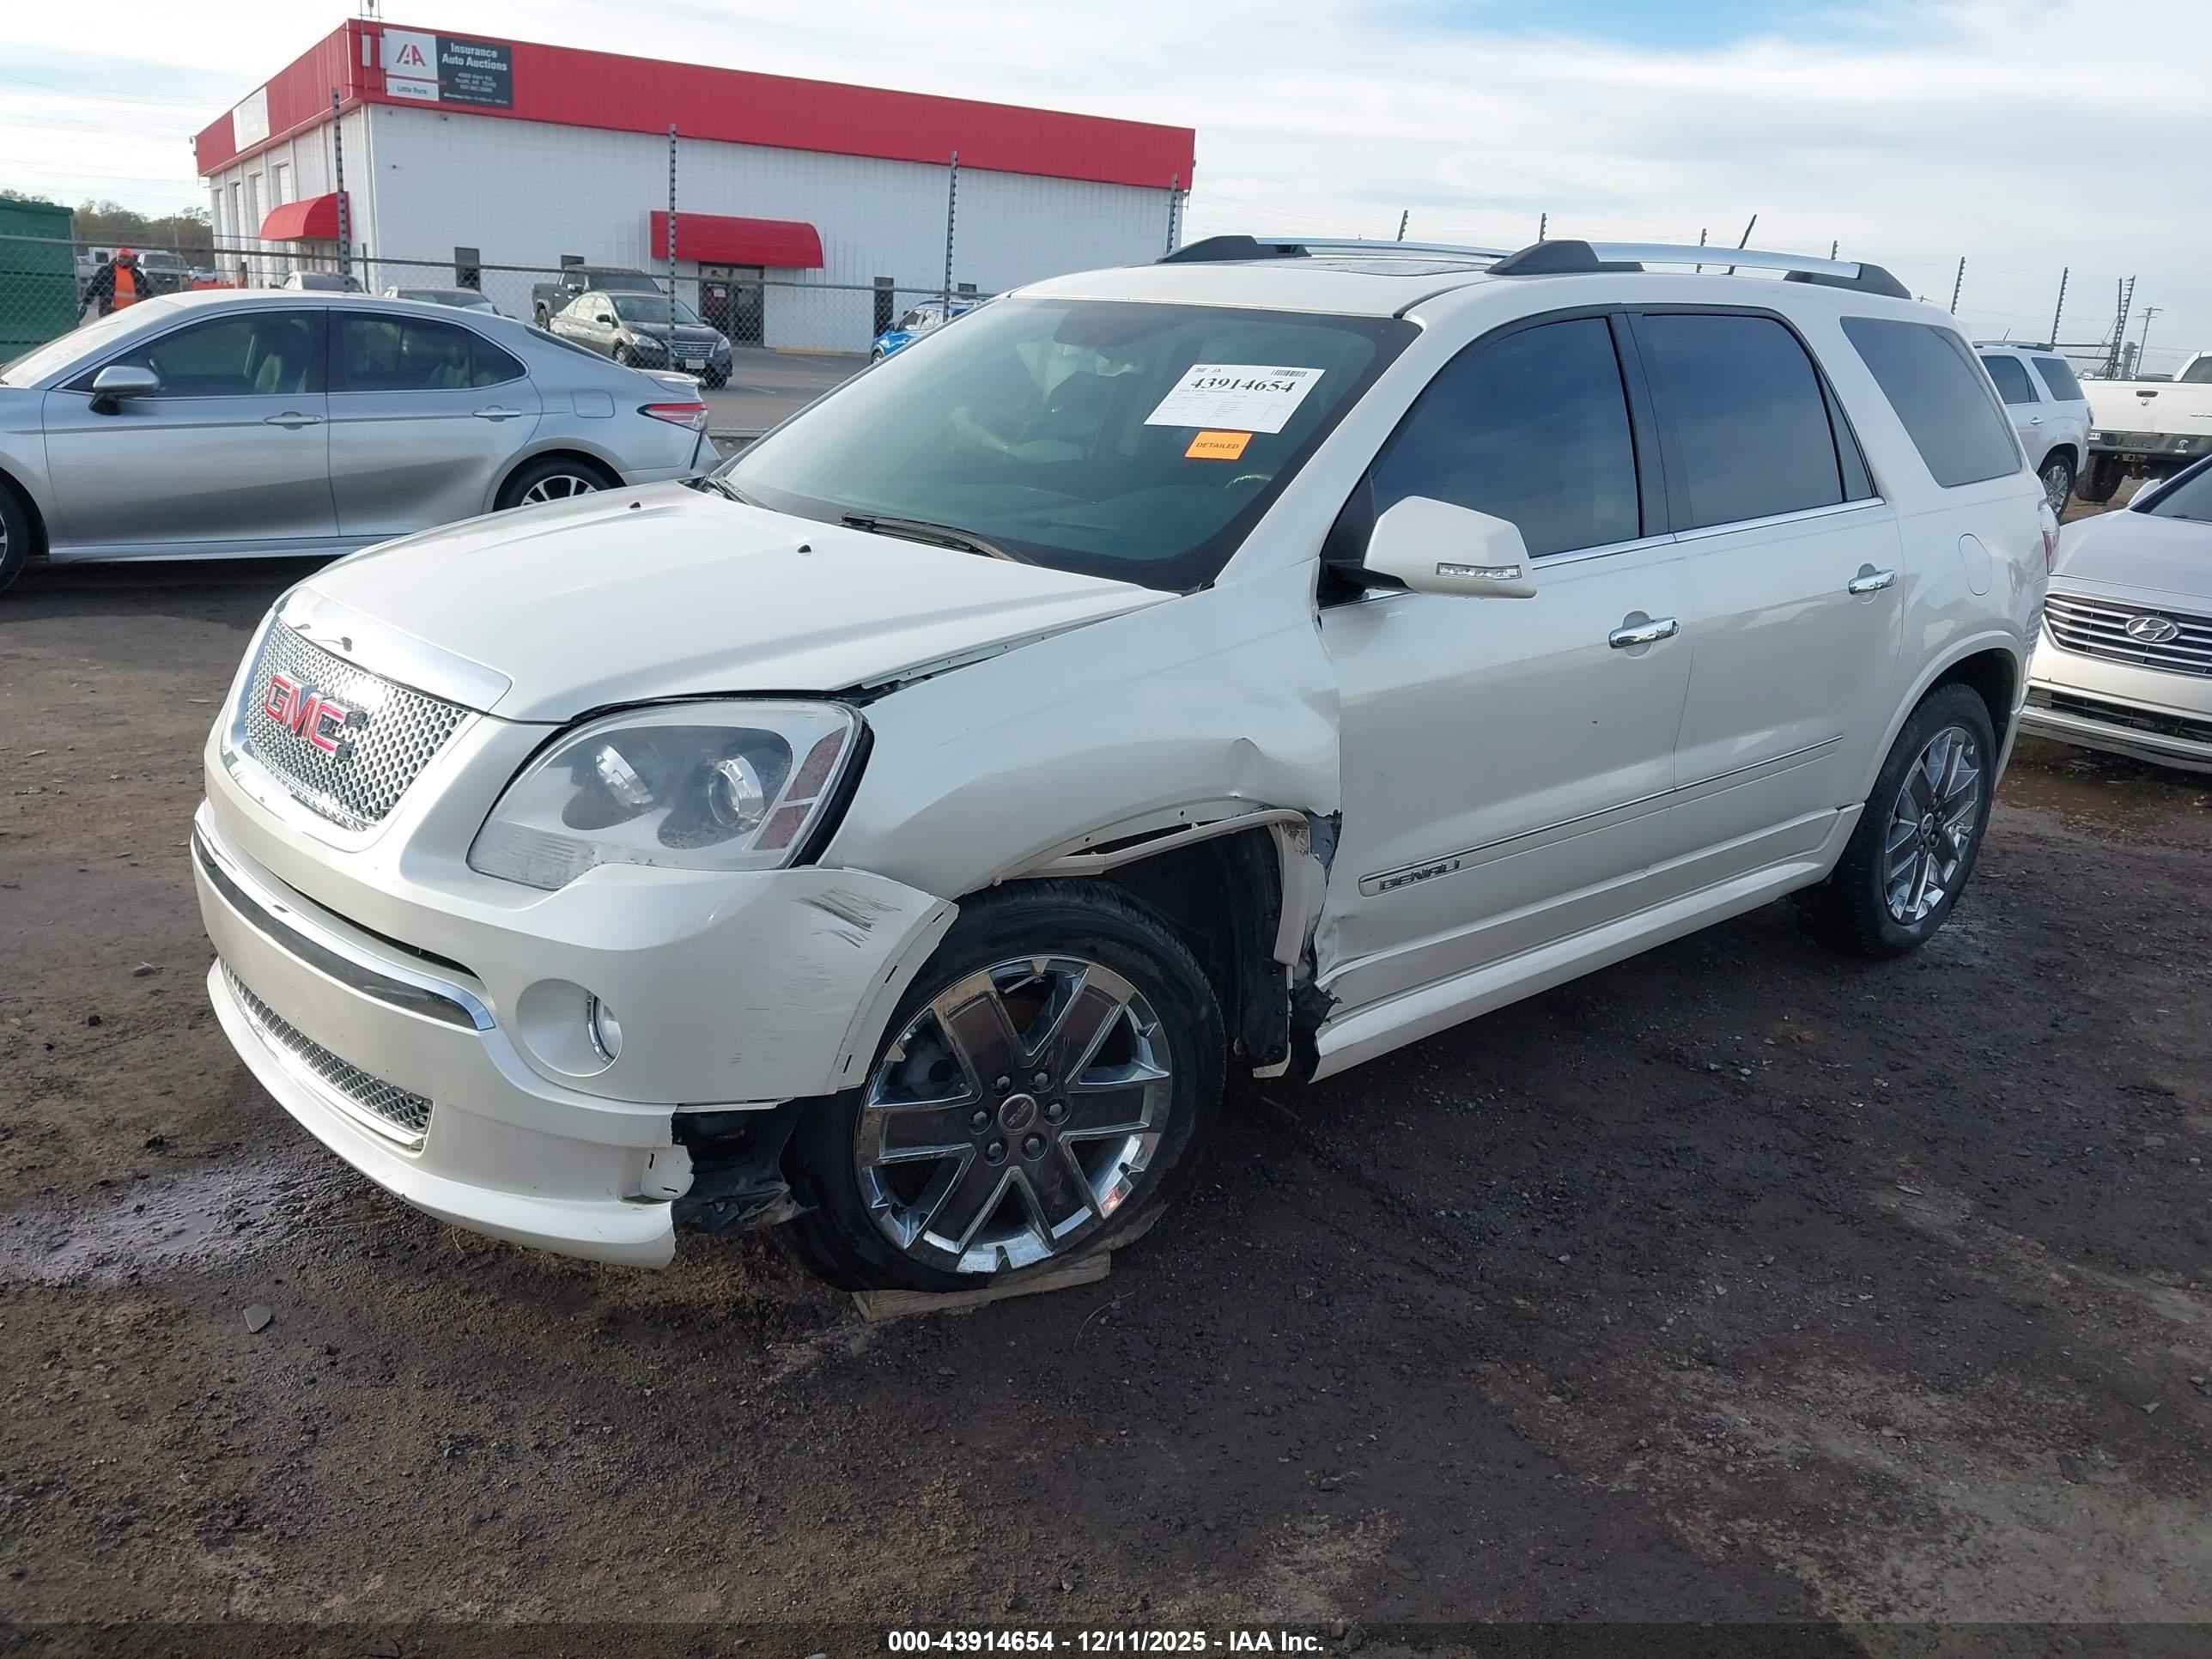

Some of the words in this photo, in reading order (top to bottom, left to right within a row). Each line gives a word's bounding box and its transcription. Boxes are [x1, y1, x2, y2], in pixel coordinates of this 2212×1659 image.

[450, 42, 498, 58] Insurance
[441, 53, 465, 66] Auto
[465, 56, 507, 71] Auctions
[1190, 377, 1296, 393] 43914654
[1196, 441, 1240, 450] DETAILED
[264, 672, 352, 757] GMC
[1379, 859, 1462, 891] DENALI
